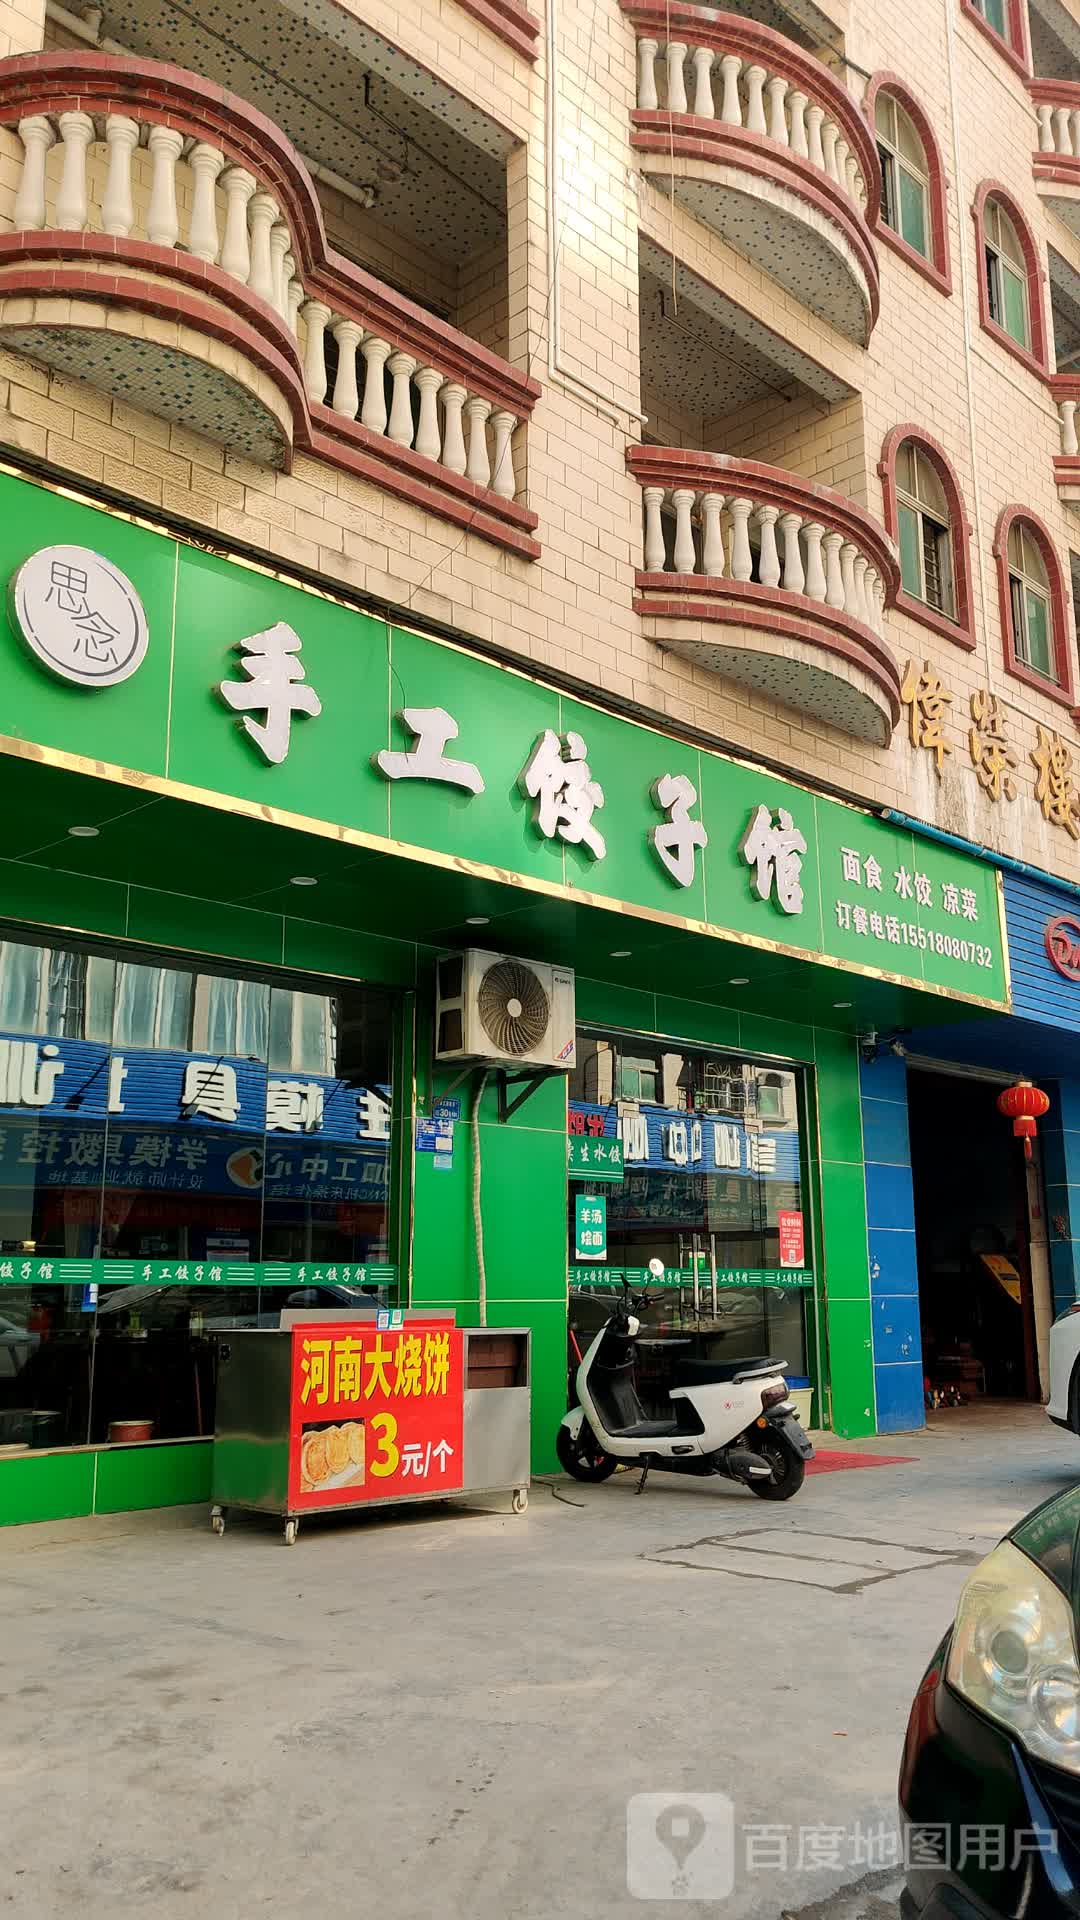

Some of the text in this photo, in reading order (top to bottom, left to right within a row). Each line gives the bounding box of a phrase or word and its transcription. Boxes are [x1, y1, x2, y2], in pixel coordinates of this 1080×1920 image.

[45, 560, 120, 665] 思念
[212, 621, 808, 915] 手工饺子馆
[841, 846, 978, 922] 面食 水饺 凉菜
[835, 899, 993, 969] 订餐电话15518080732
[580, 1208, 602, 1224] 羊汤
[580, 1230, 602, 1246] 烩面
[0, 1262, 54, 1280] 饺子馆
[142, 1264, 224, 1282] 手工饺子馆
[297, 1267, 366, 1283] 手工饺子馆
[576, 1270, 610, 1283] 手工饺子馆
[301, 1332, 451, 1405] 河南大烧饼
[369, 1412, 454, 1478] 3元/个
